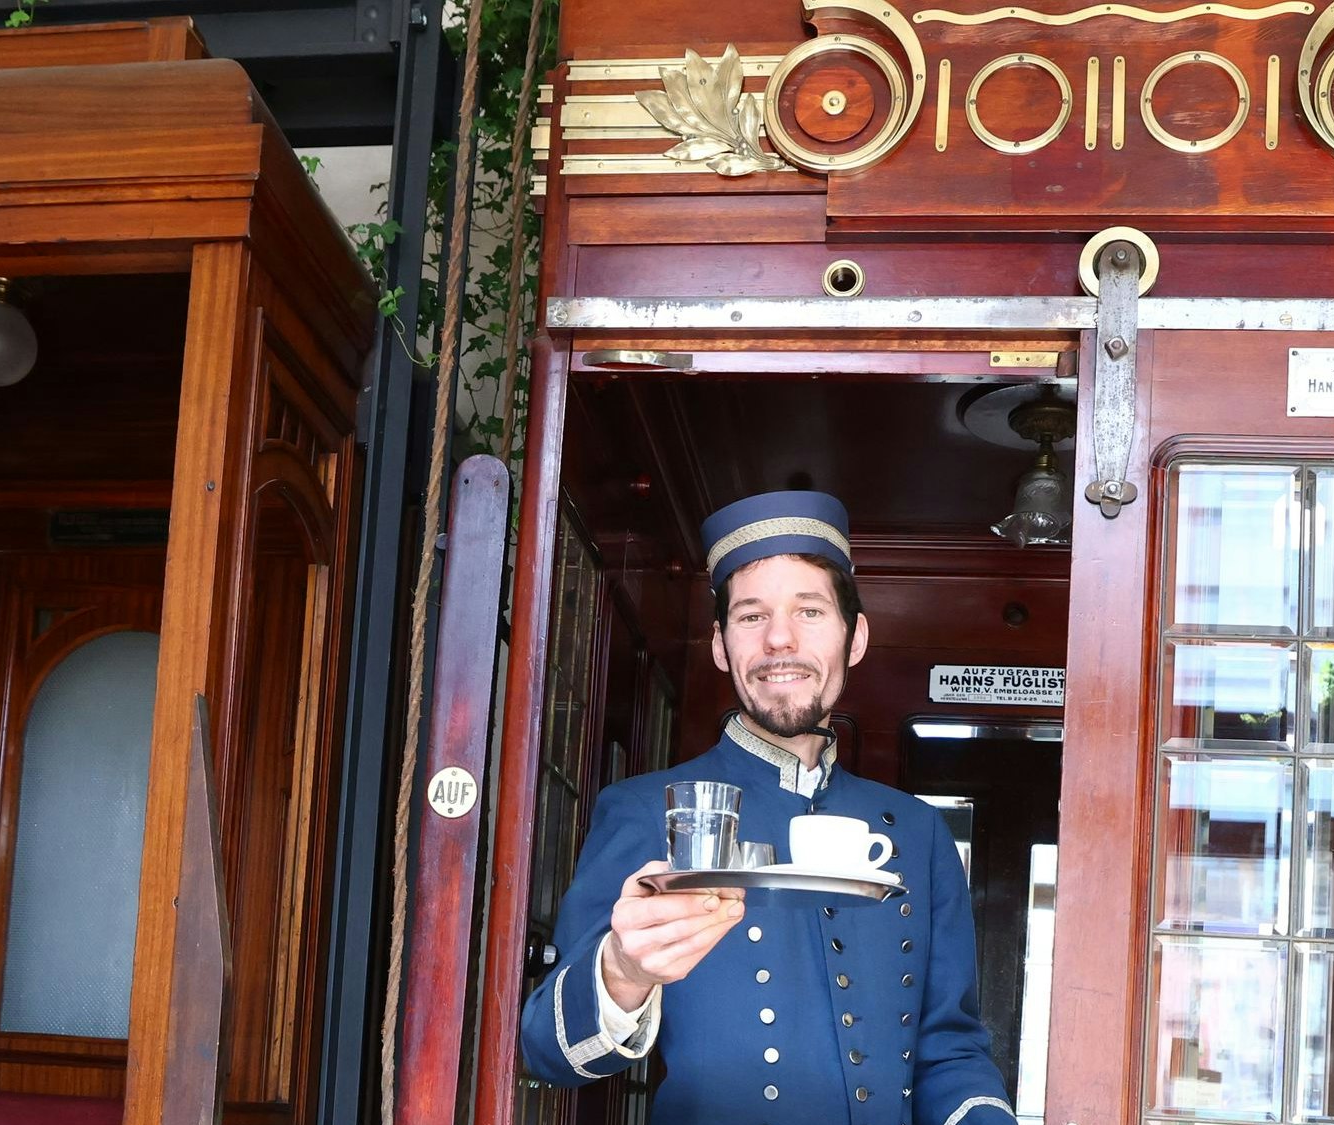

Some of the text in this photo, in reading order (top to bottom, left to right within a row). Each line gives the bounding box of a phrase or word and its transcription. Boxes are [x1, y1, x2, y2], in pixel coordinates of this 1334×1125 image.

[939, 675, 1065, 689] HANNS FÜGLIST
[432, 780, 474, 805] AUF
